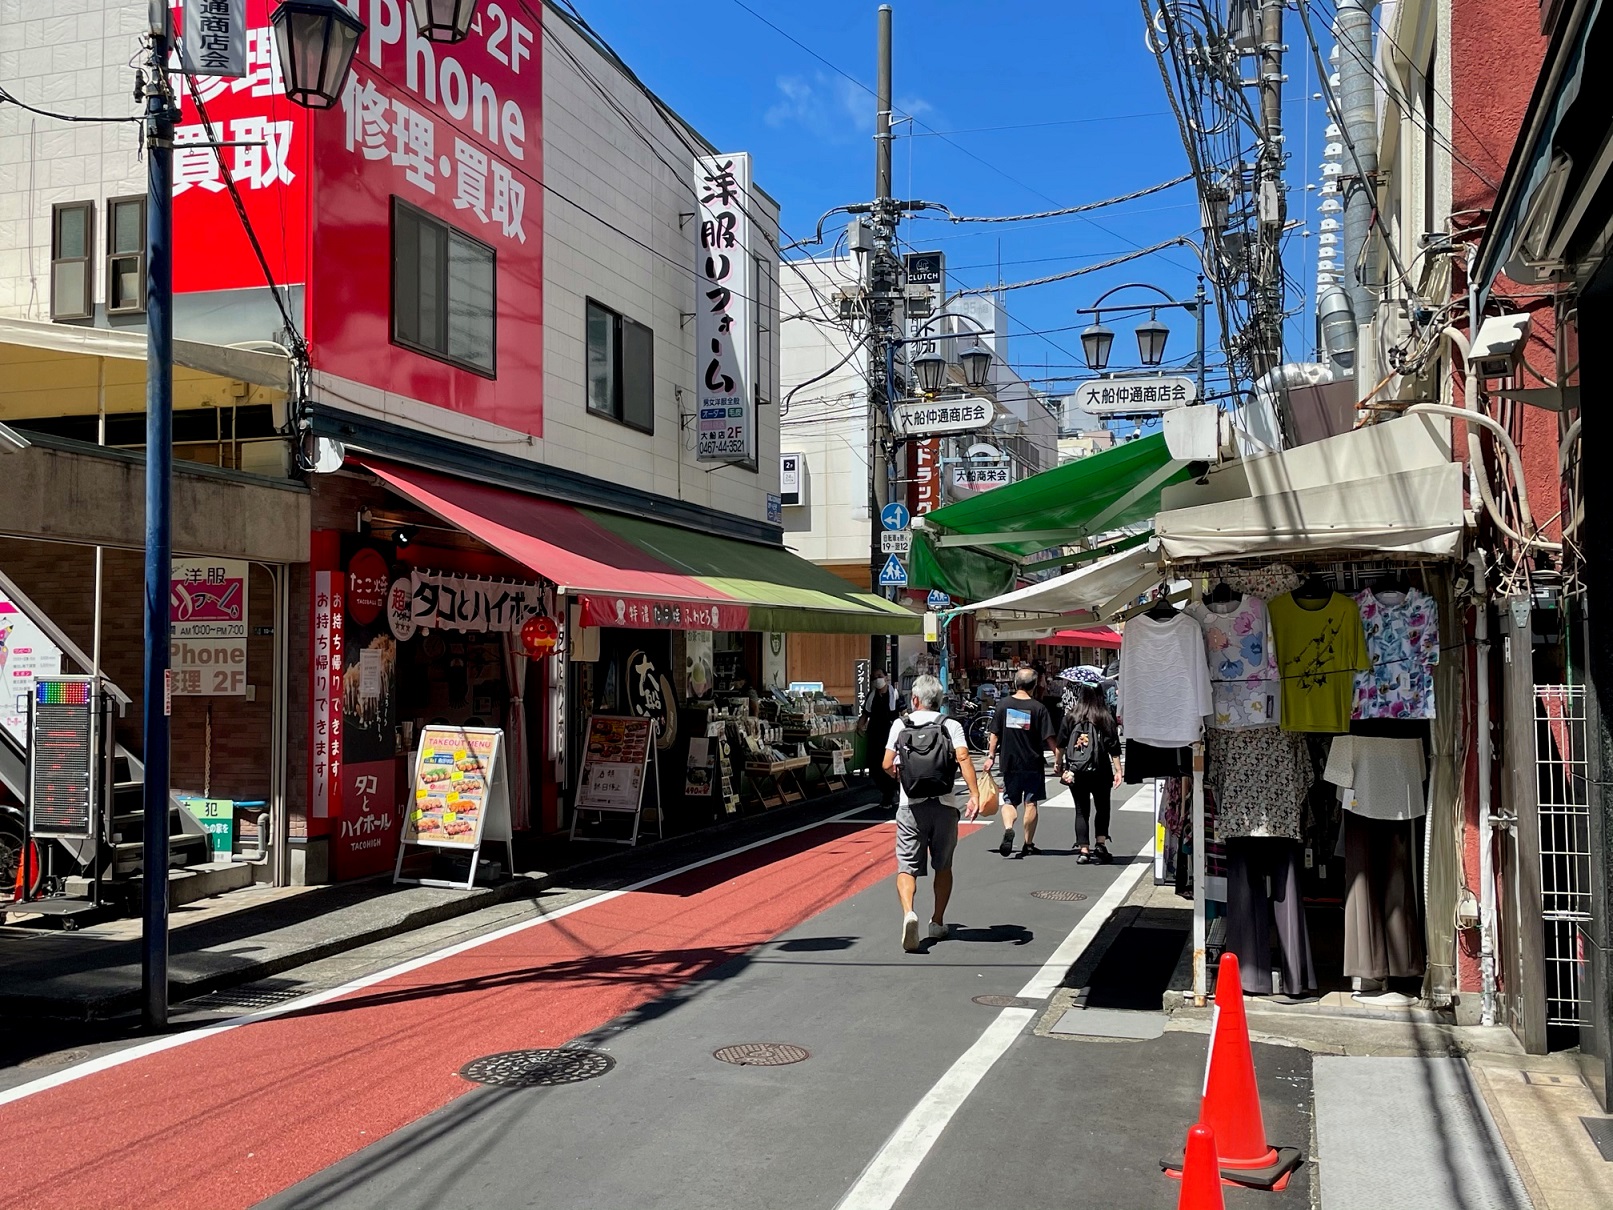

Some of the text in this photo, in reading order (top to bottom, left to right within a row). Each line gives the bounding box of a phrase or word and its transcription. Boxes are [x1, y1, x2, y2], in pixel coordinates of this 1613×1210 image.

[486, 3, 534, 75] 2F
[172, 116, 296, 197] 買取
[341, 67, 527, 245] 修理・買取
[908, 272, 938, 281] CLUTCH
[1086, 384, 1186, 405] 大船仲通商店会
[901, 405, 985, 427] 大船仲通商店会
[727, 426, 742, 439] 2F
[956, 470, 1007, 482] 大船商栄会
[184, 567, 226, 585] 洋服
[350, 572, 388, 596] たこ焼
[171, 643, 245, 664] Phone
[212, 671, 244, 693] 2F
[429, 738, 492, 749] TAKEOUT MENU
[354, 775, 378, 796] タコ
[362, 795, 370, 812] と
[340, 813, 392, 838] ハイボール
[350, 838, 382, 851] TACOHIGH
